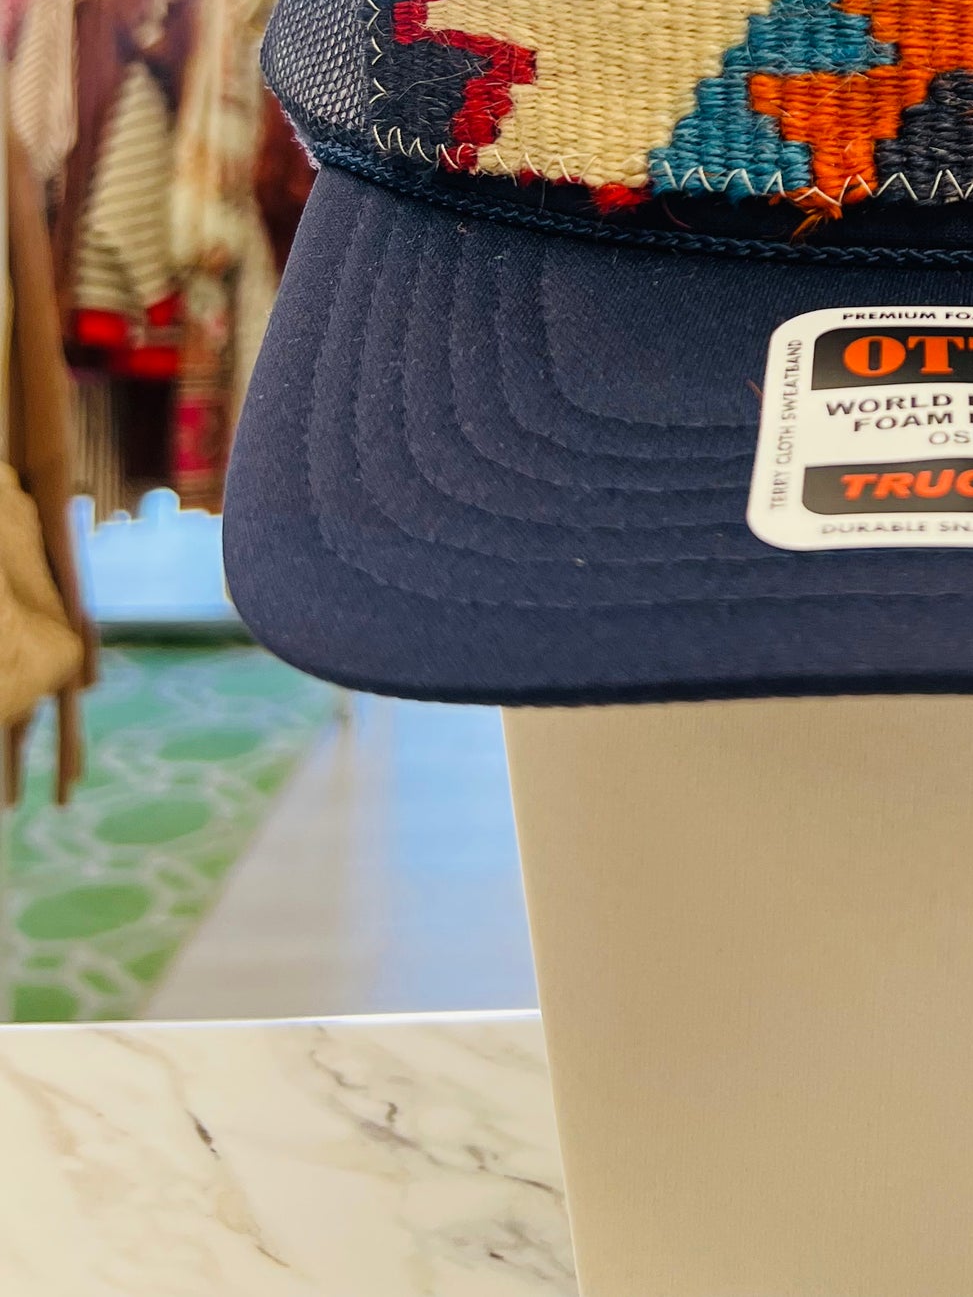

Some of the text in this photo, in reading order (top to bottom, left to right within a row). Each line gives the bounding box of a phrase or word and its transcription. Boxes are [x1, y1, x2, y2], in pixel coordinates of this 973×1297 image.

[843, 312, 936, 321] PREMIUM
[826, 393, 952, 416] WORLD
[770, 339, 803, 511] TERRY CLOTH SWEATBAND
[853, 411, 952, 432] FOAM
[821, 522, 925, 535] DURABLE
